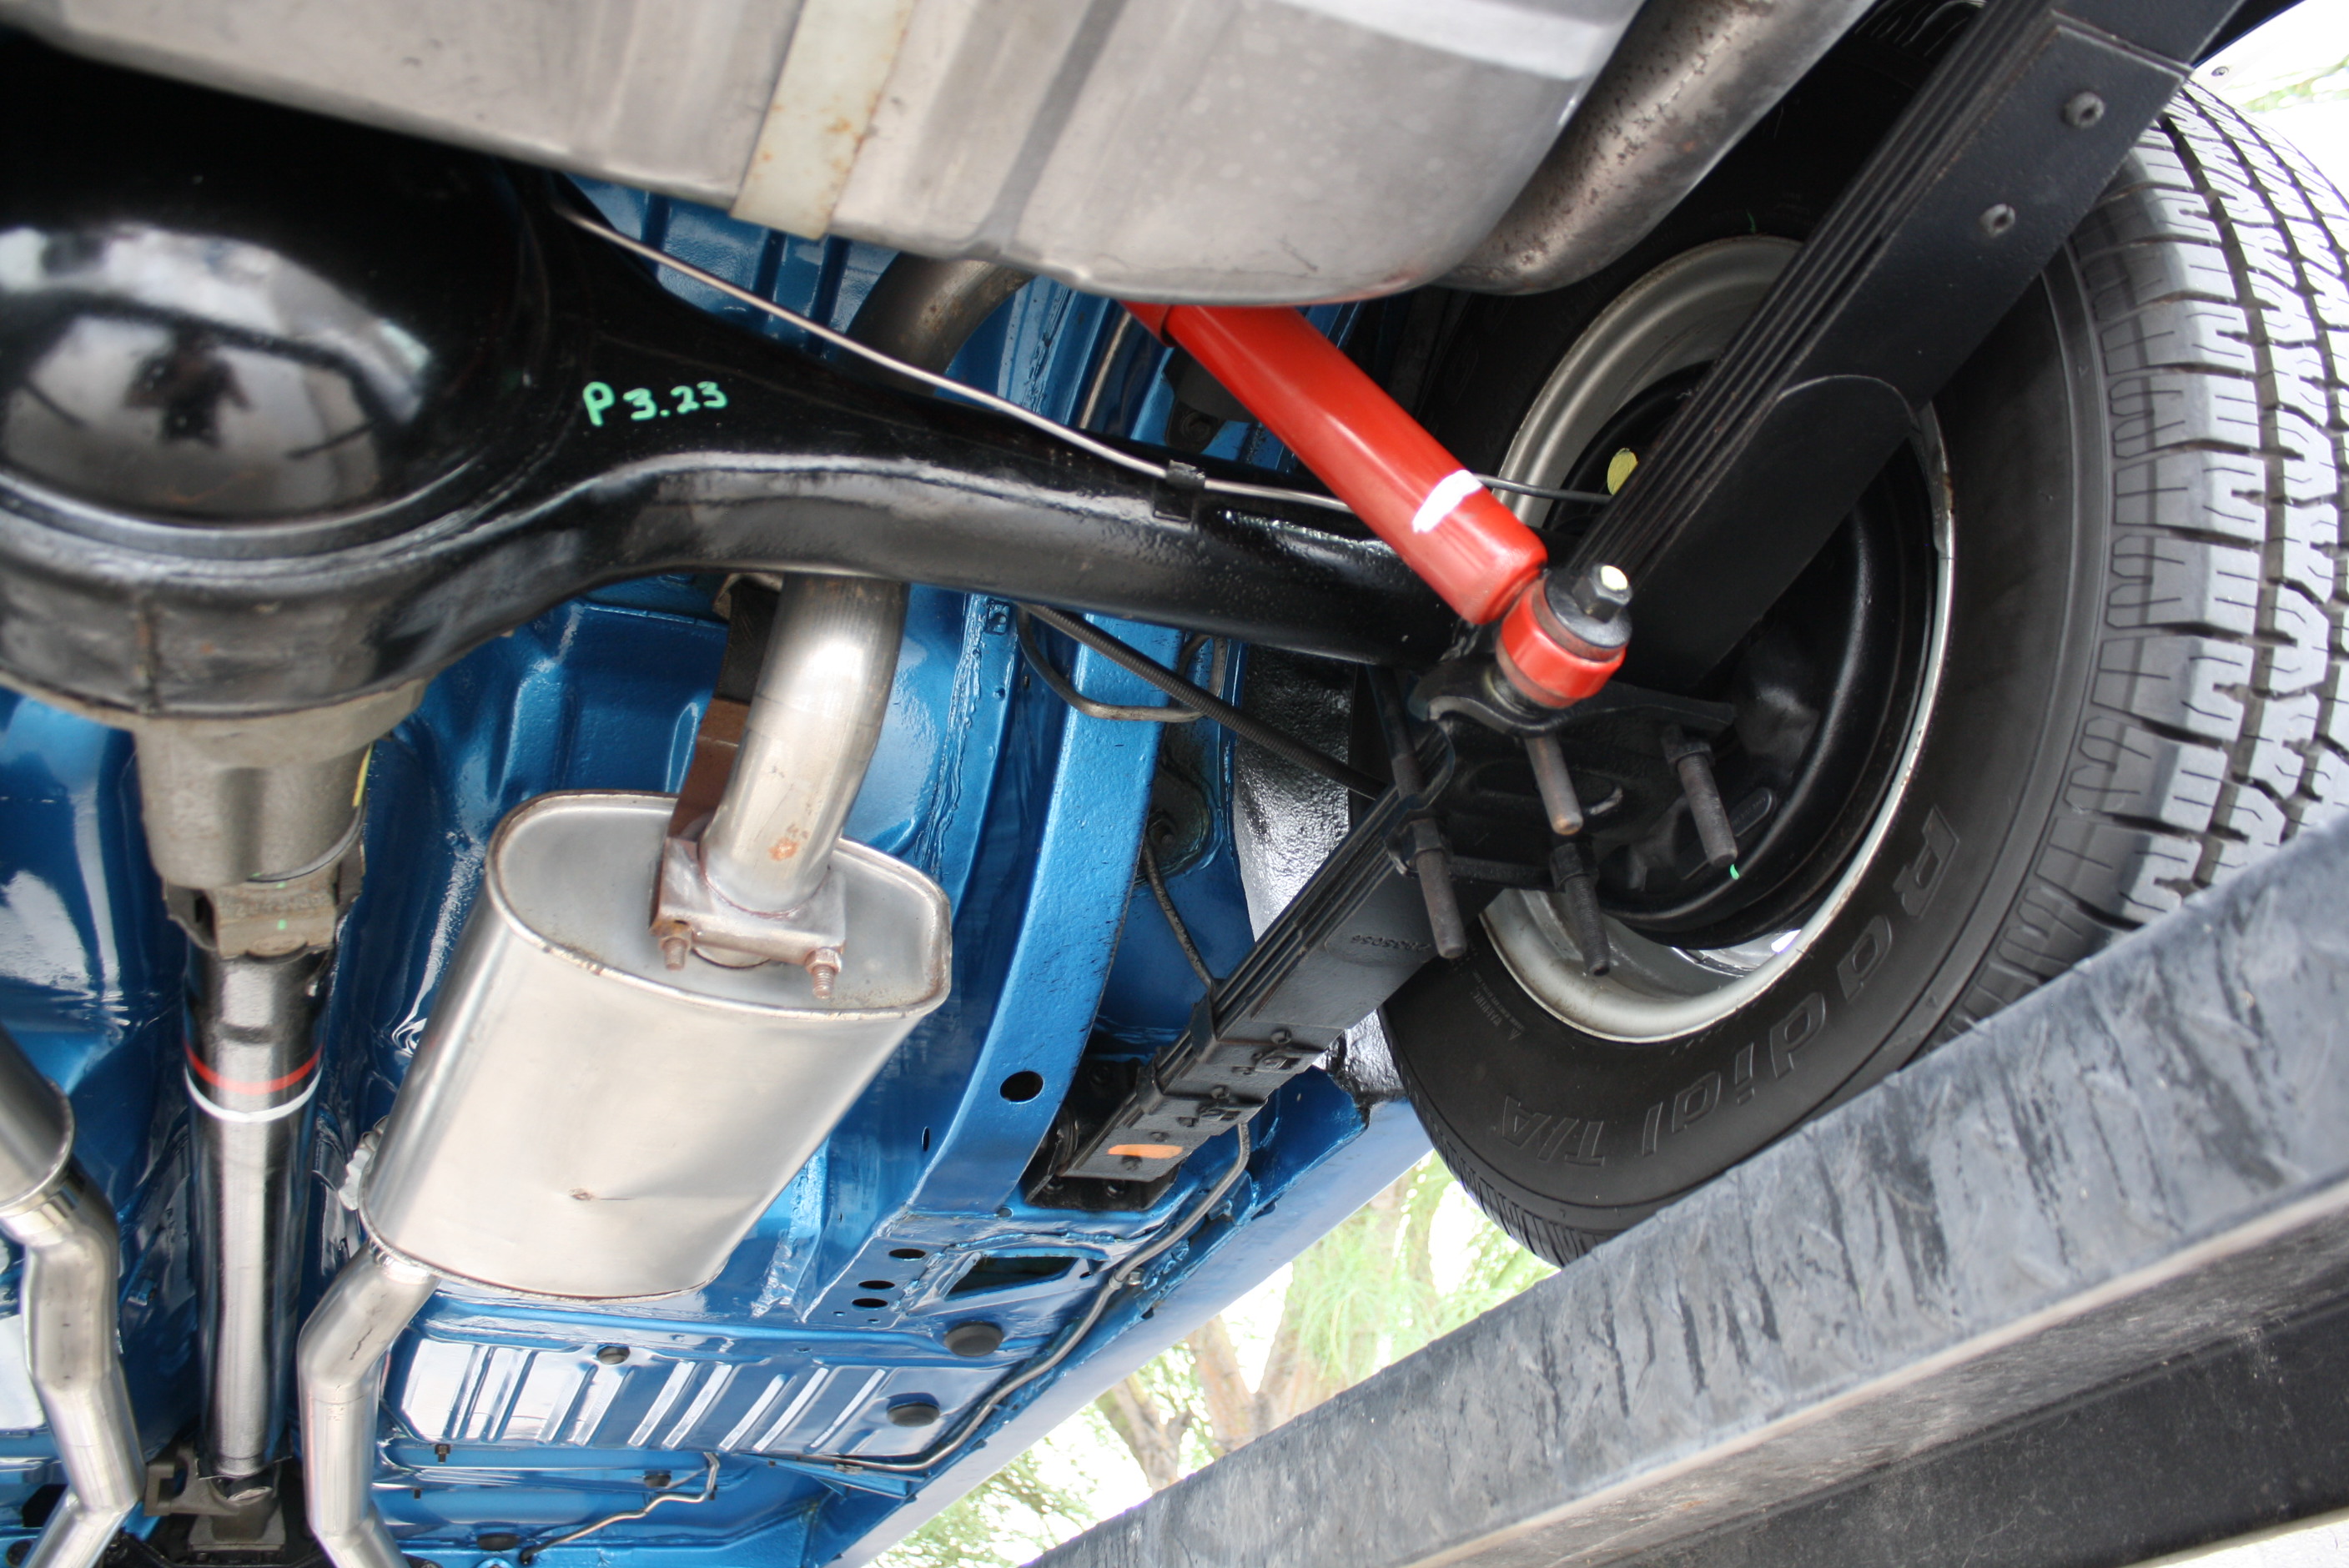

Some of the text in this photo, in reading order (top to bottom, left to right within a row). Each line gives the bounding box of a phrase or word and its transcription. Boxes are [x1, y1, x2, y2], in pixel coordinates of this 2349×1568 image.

[582, 380, 728, 426] P 3.23
[1501, 804, 1959, 1167] Radial T/A
